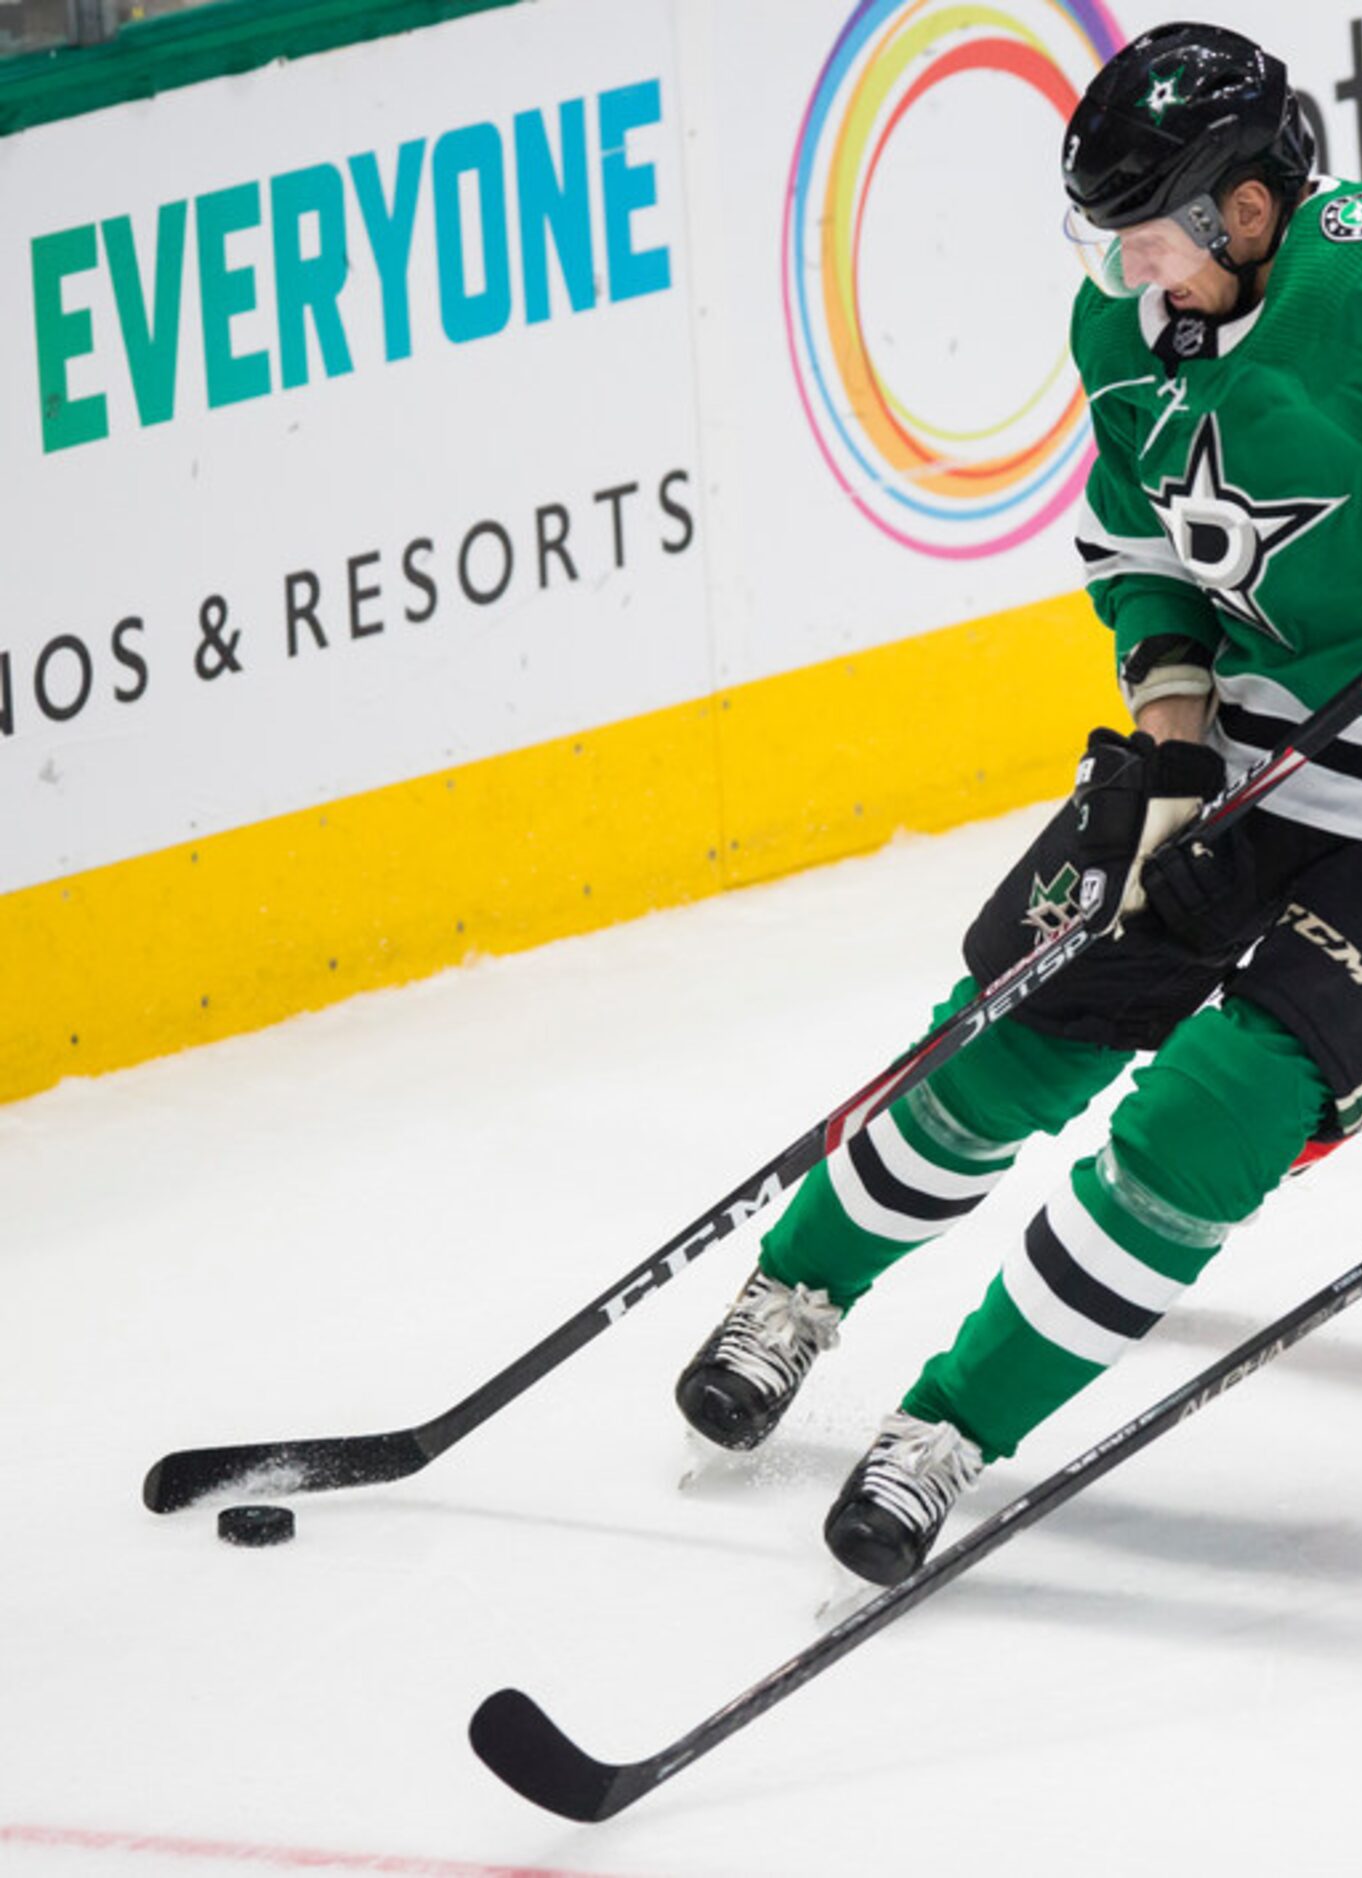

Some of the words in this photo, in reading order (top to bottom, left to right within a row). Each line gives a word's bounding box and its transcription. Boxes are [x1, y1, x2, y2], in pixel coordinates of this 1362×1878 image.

[30, 78, 672, 455] EVERYONE
[194, 594, 243, 681] &
[284, 470, 695, 658] RESORTS
